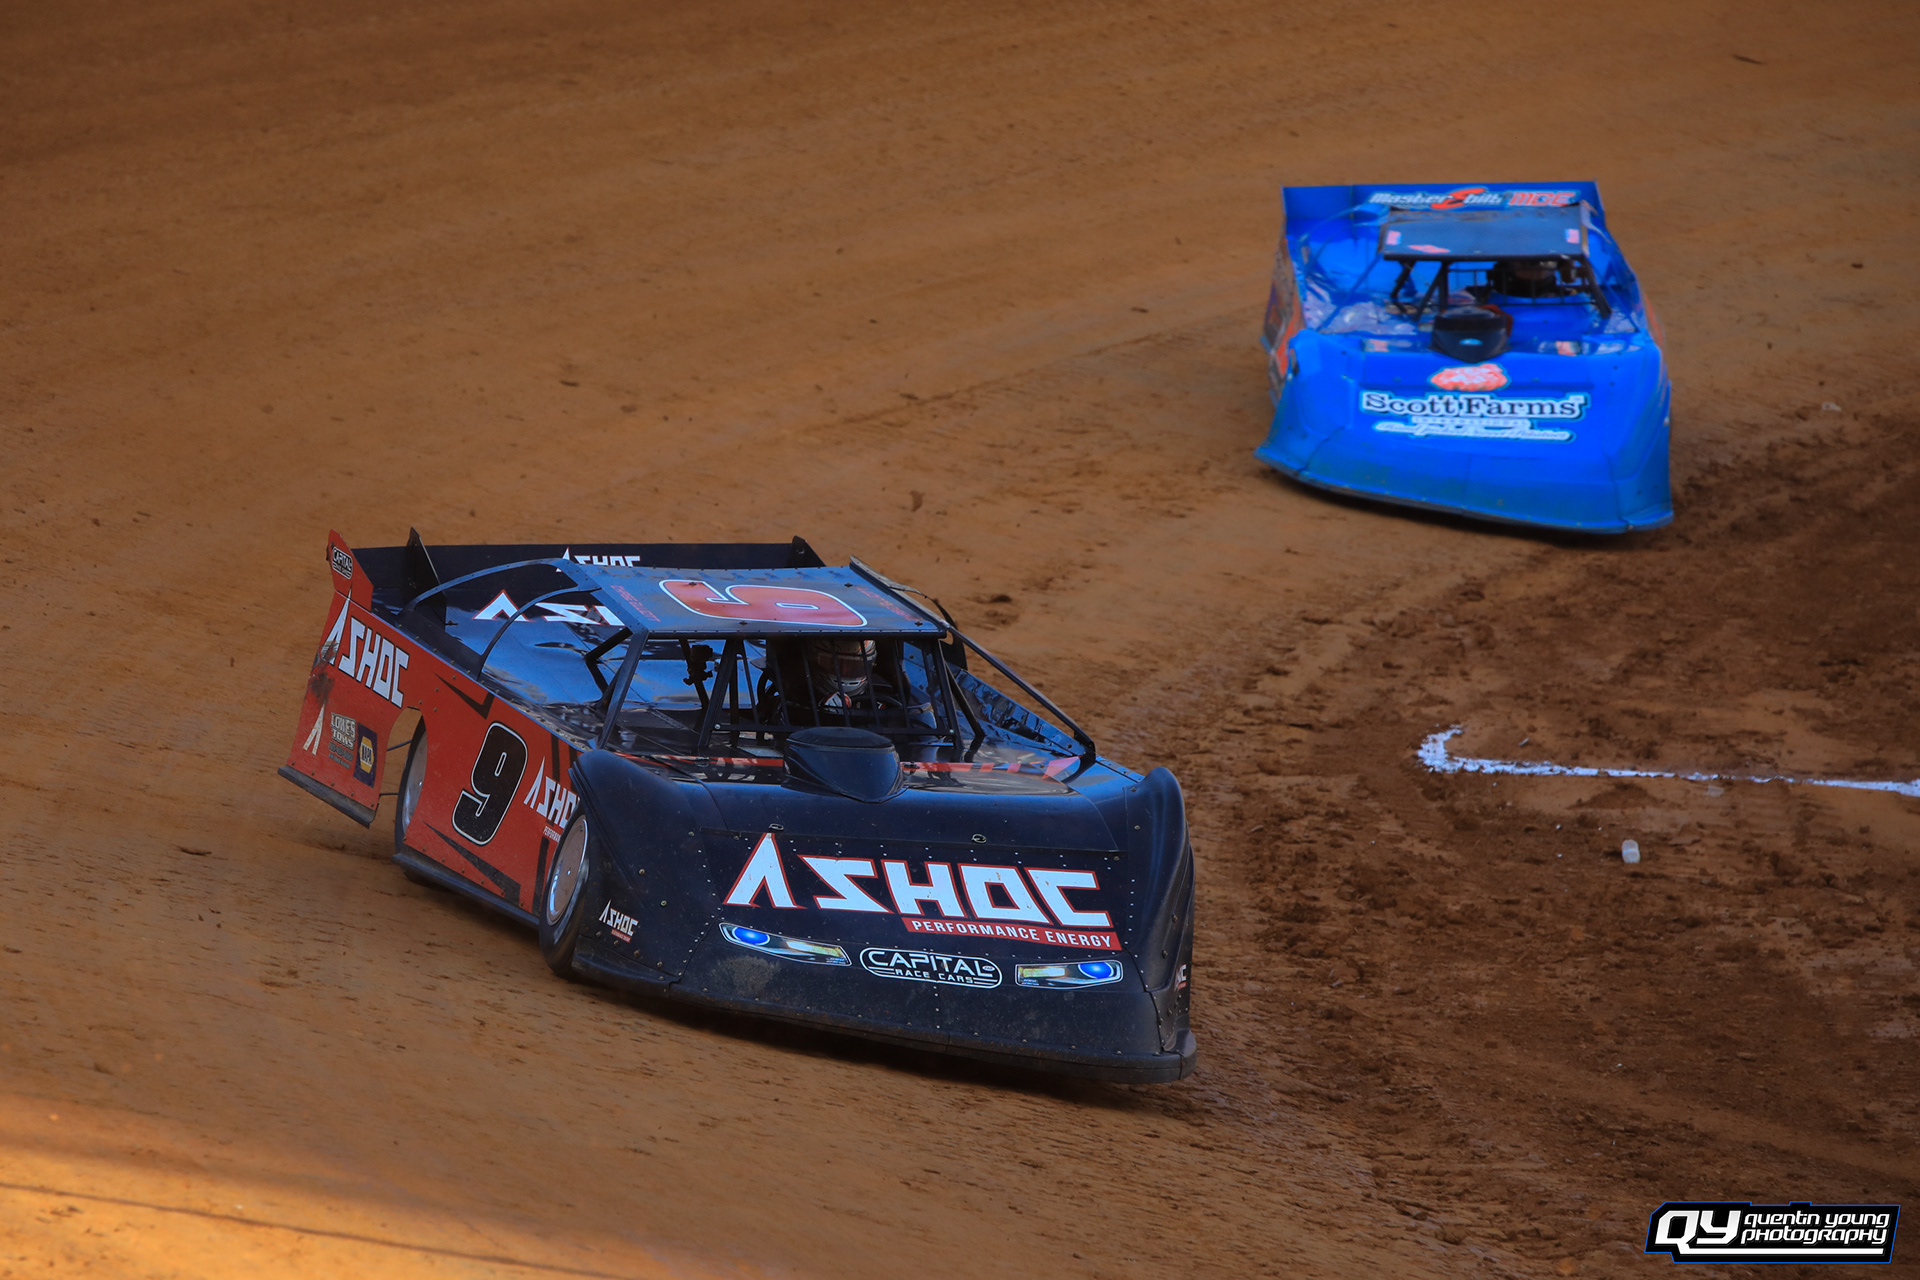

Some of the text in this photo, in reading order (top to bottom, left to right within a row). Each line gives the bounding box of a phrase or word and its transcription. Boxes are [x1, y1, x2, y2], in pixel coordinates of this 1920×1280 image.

[1365, 392, 1576, 416] Scott Farms
[452, 721, 528, 846] 9
[523, 756, 580, 829] ASHO
[723, 832, 1113, 928] ASHOC
[598, 899, 639, 937] ASHOC
[911, 920, 1112, 948] PERFORMANCE ENERGY
[868, 950, 994, 978] CAPITAL
[895, 968, 974, 984] RACE CARS
